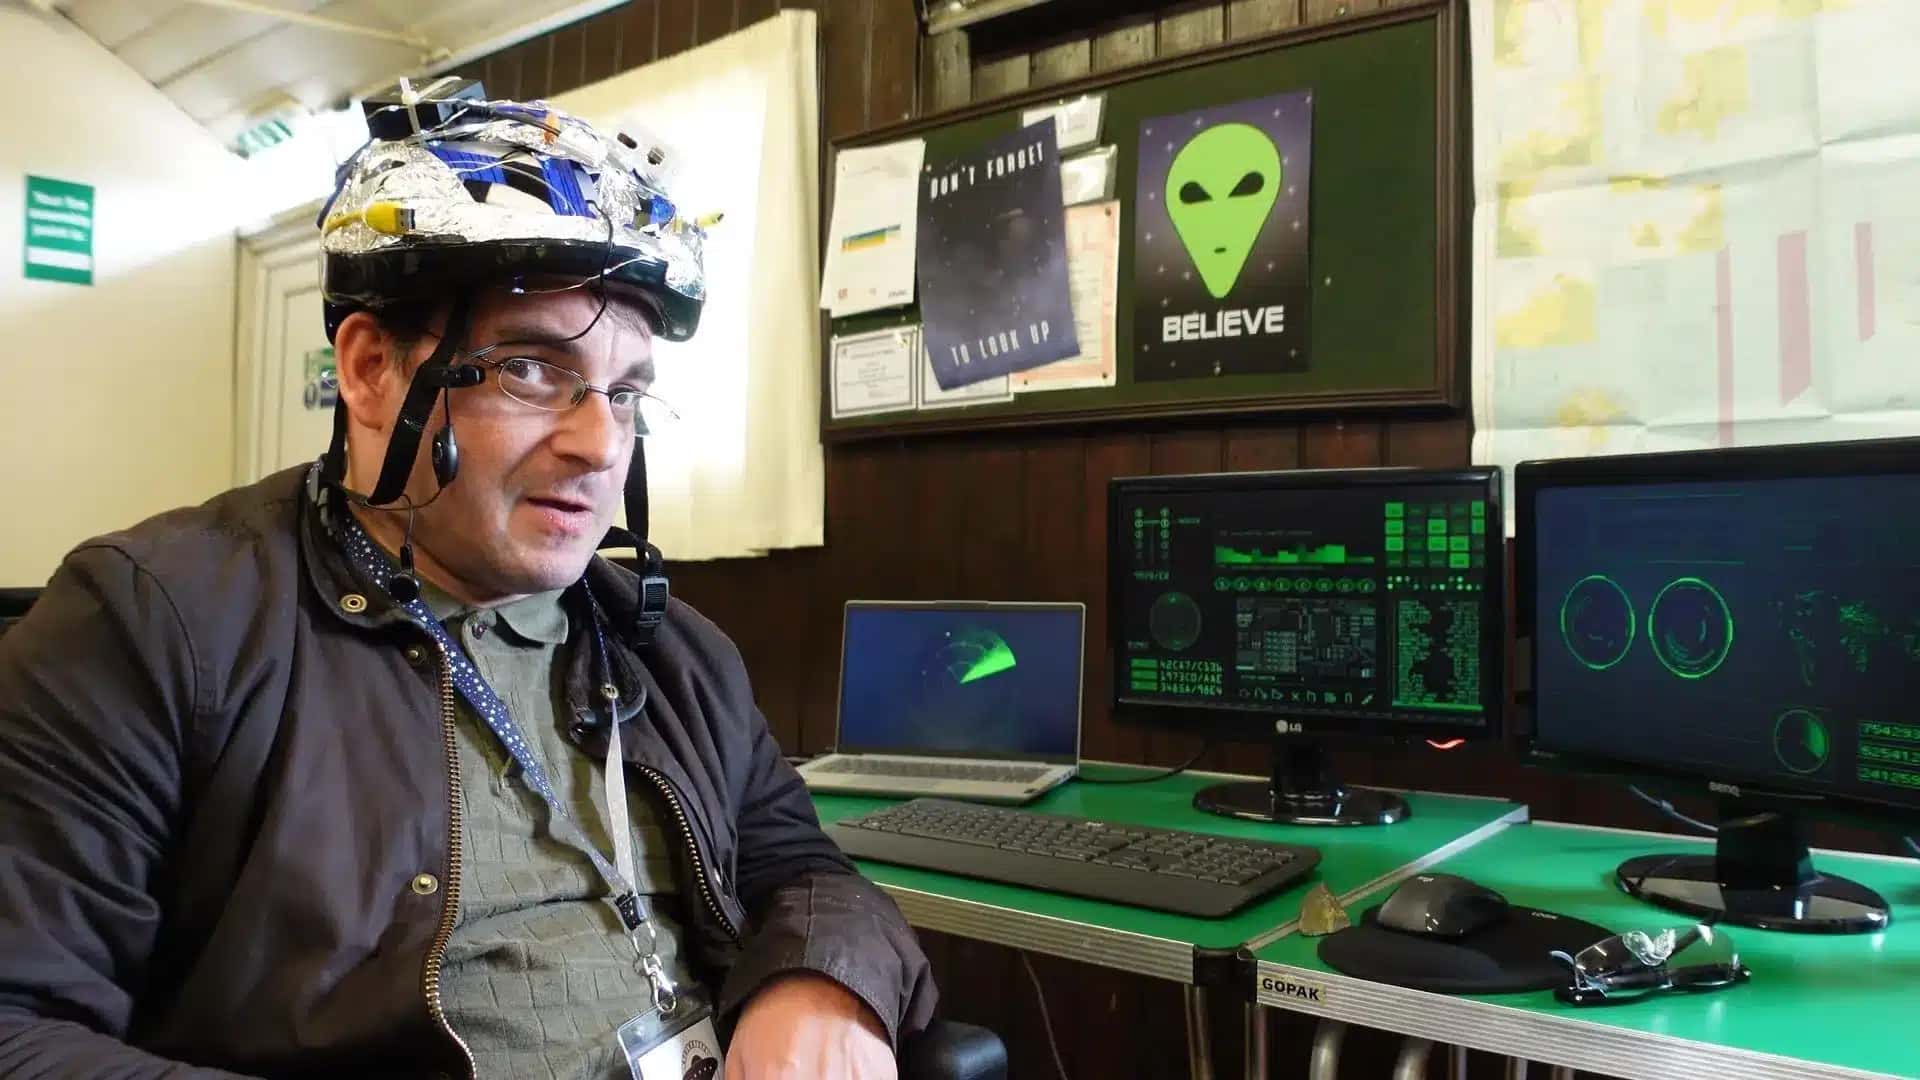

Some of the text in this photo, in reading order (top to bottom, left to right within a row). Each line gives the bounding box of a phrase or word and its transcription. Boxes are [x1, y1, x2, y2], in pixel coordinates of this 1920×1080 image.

[930, 141, 1044, 200] DON'T FORGET
[1162, 304, 1285, 343] BELIEVE
[951, 320, 1050, 368] TO LOOK UP
[1289, 722, 1302, 733] LG
[1262, 978, 1321, 1001] GOPAK
